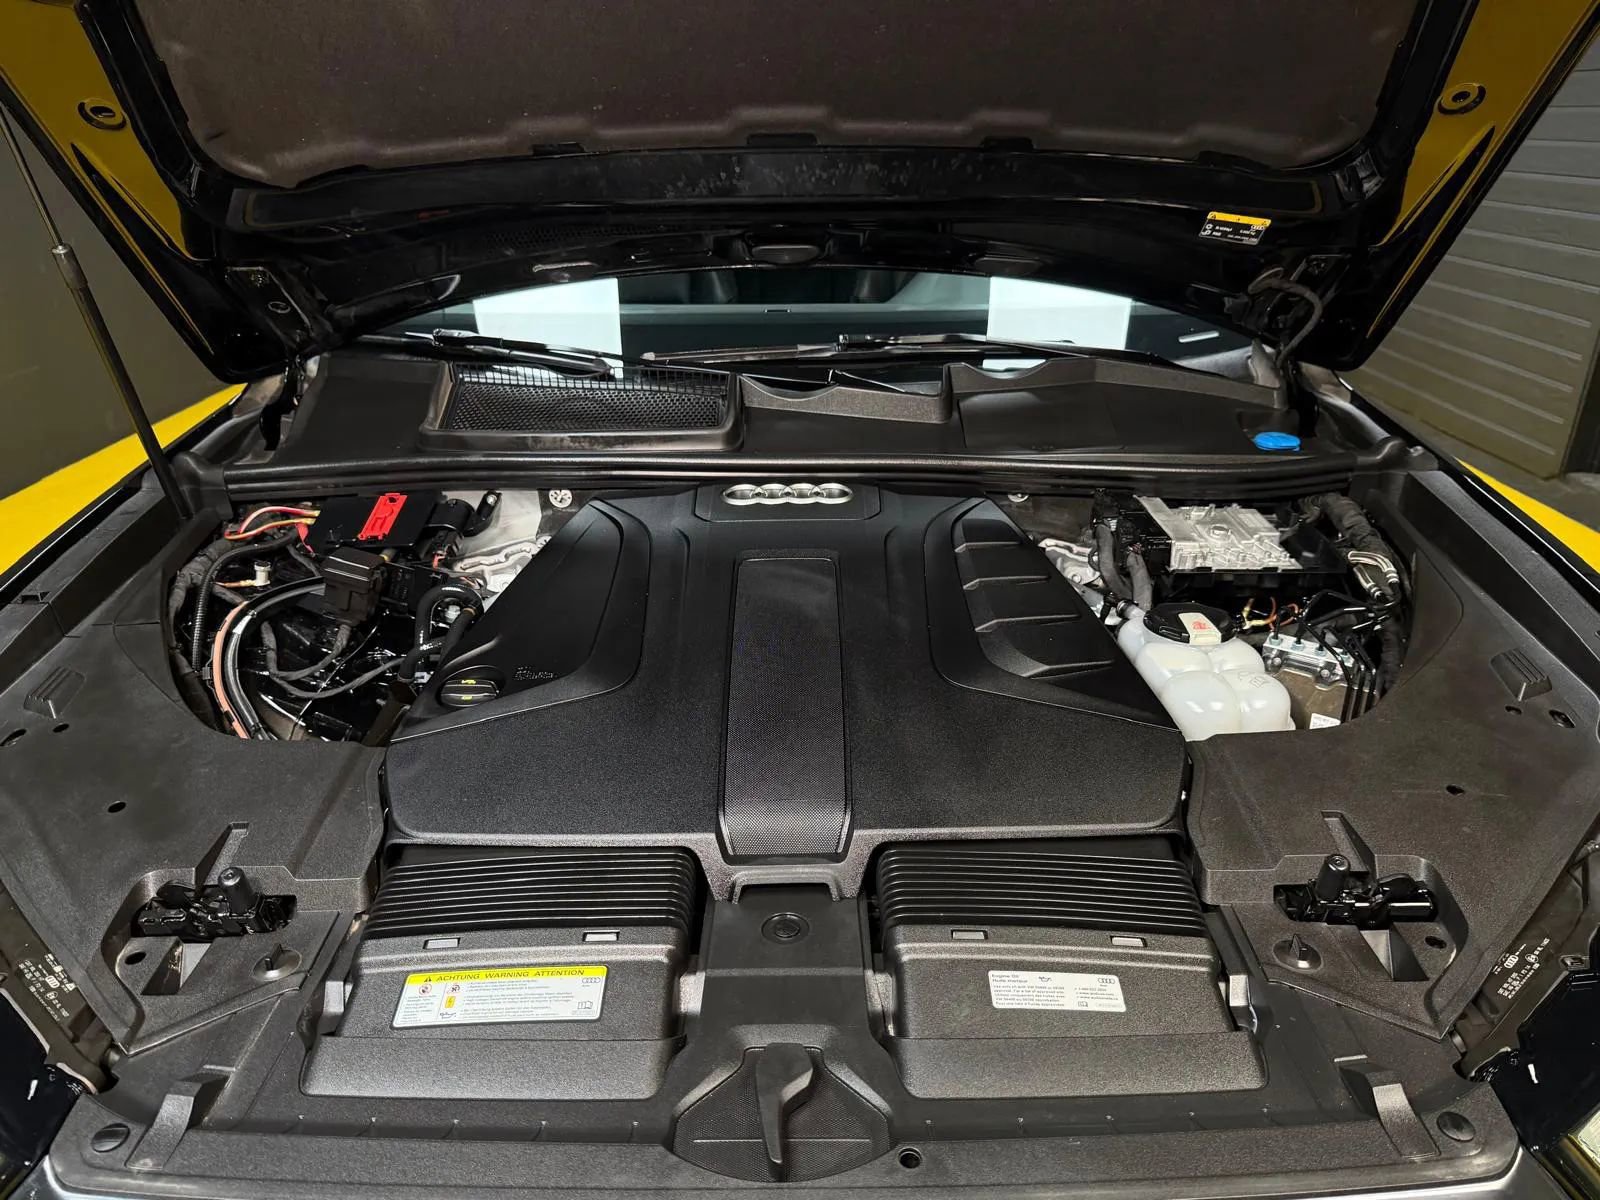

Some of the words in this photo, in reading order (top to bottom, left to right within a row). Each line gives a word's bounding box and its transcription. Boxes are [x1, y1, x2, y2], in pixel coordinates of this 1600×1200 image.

[436, 973, 480, 982] ACHTUNG
[484, 970, 529, 979] WARNING
[534, 969, 585, 977] ATTENTION
